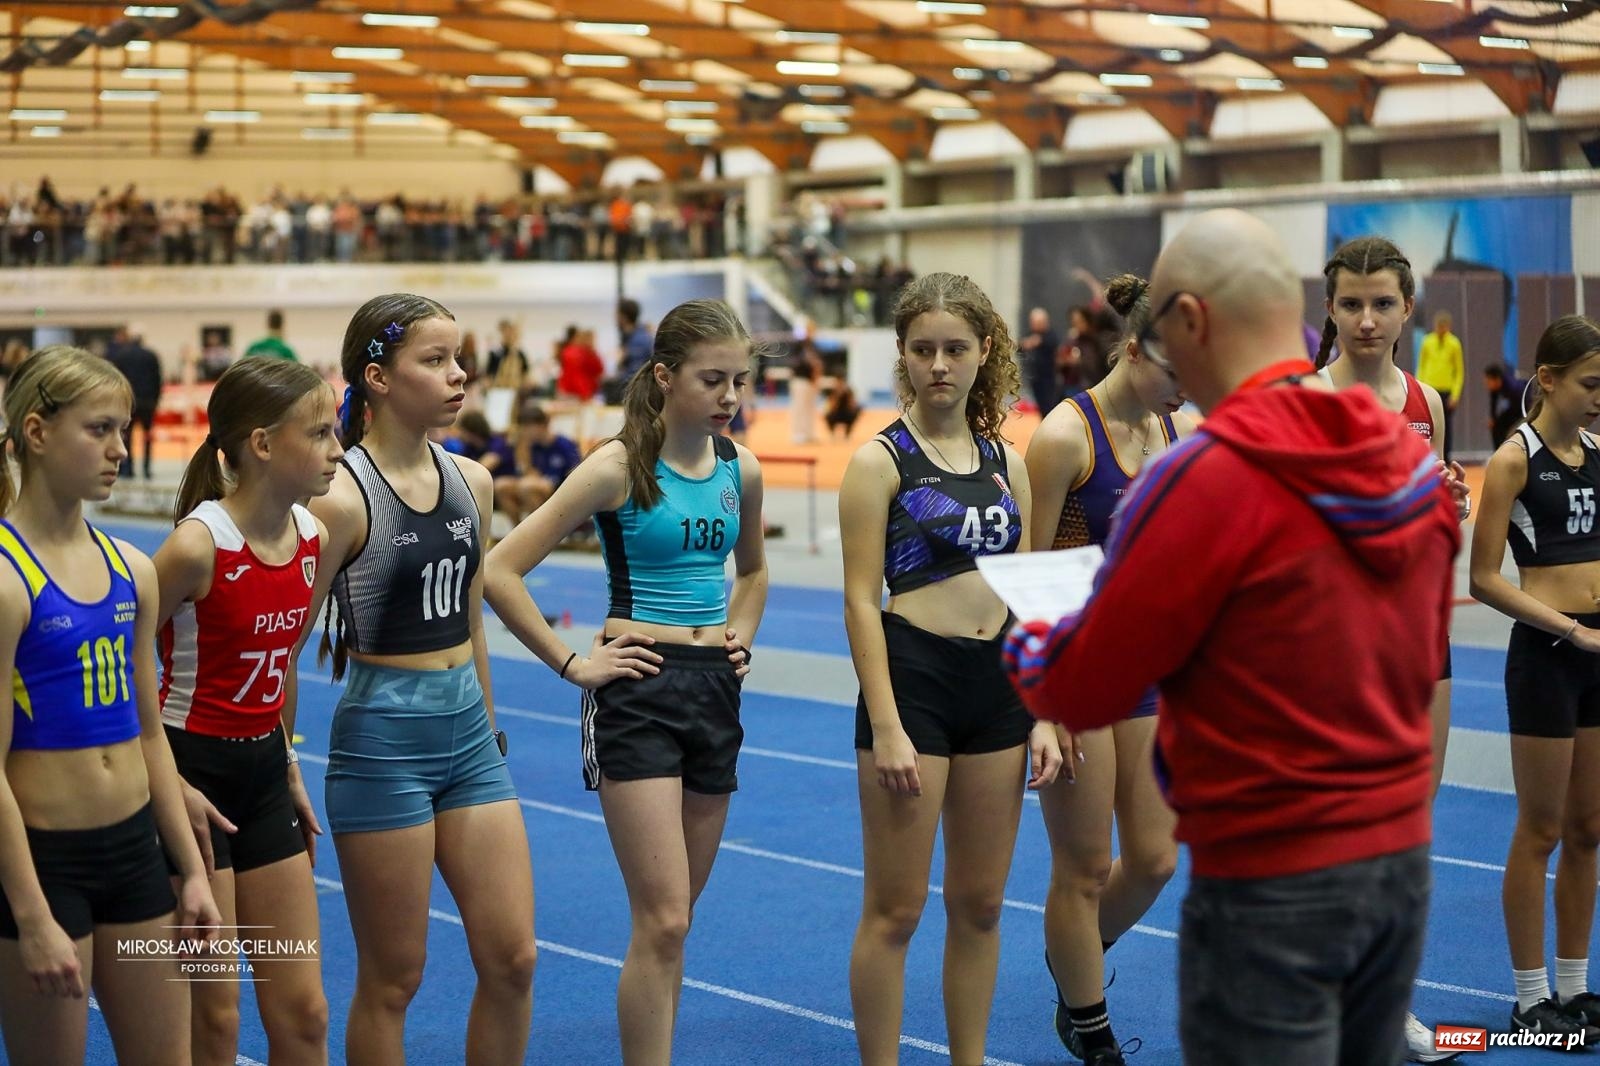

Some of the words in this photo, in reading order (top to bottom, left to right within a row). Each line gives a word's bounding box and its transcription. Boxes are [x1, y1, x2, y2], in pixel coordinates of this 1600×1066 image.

[1539, 471, 1561, 481] esa
[445, 516, 472, 530] UKS
[1566, 487, 1596, 534] 55
[392, 532, 419, 547] esa
[680, 517, 726, 552] 136
[957, 505, 1010, 552] 43
[421, 555, 467, 621] 101
[38, 614, 73, 634] esa
[254, 606, 308, 635] PIAST
[77, 635, 131, 708] 101
